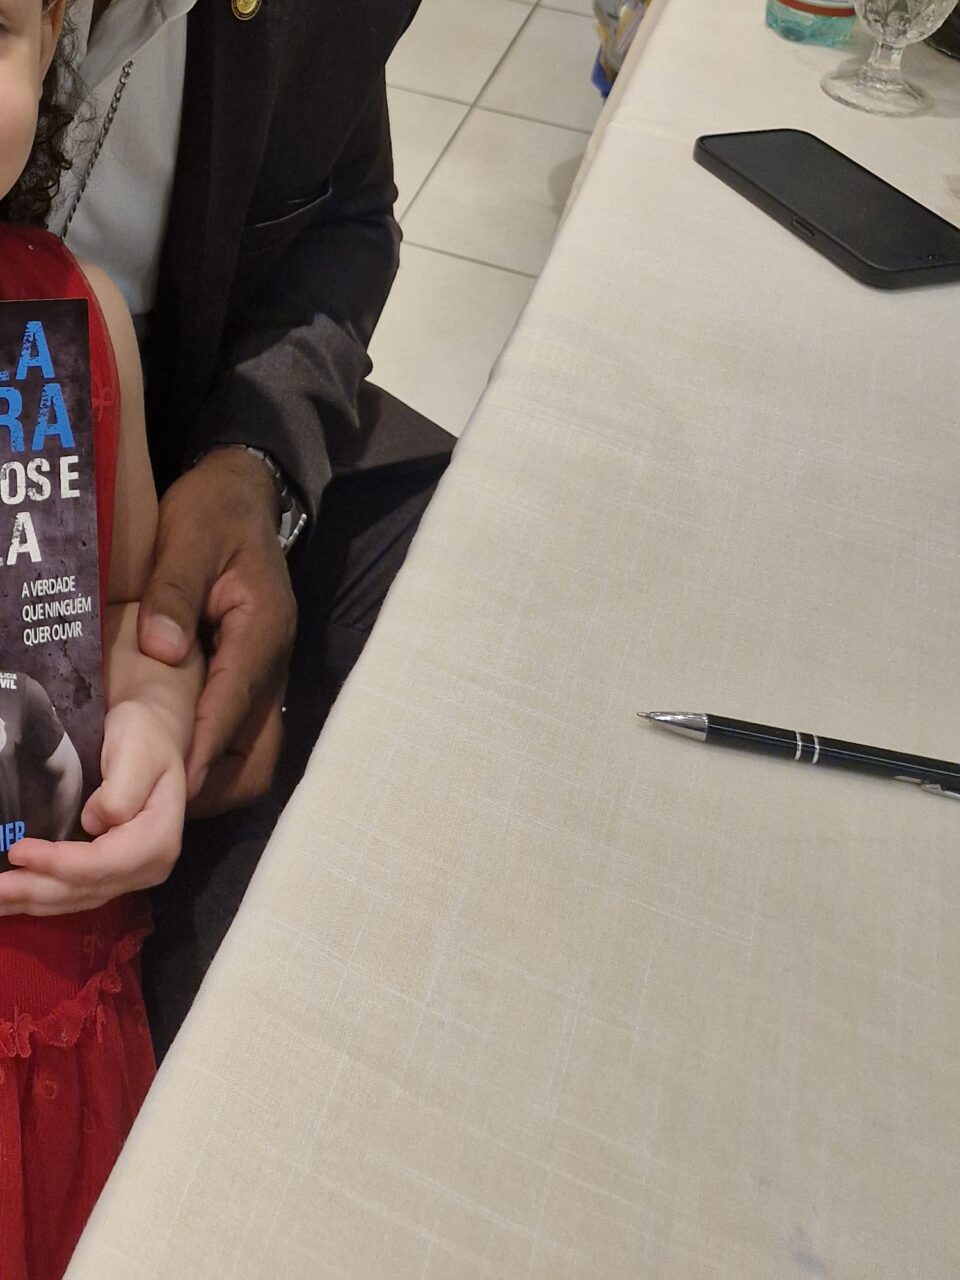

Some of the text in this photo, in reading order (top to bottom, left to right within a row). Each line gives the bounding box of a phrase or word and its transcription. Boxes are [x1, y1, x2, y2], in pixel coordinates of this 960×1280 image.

[59, 455, 81, 499] E
[21, 575, 76, 598] A VERDADE
[22, 593, 92, 623] QUE NINGUÉM
[23, 621, 83, 646] QUER OUVIR
